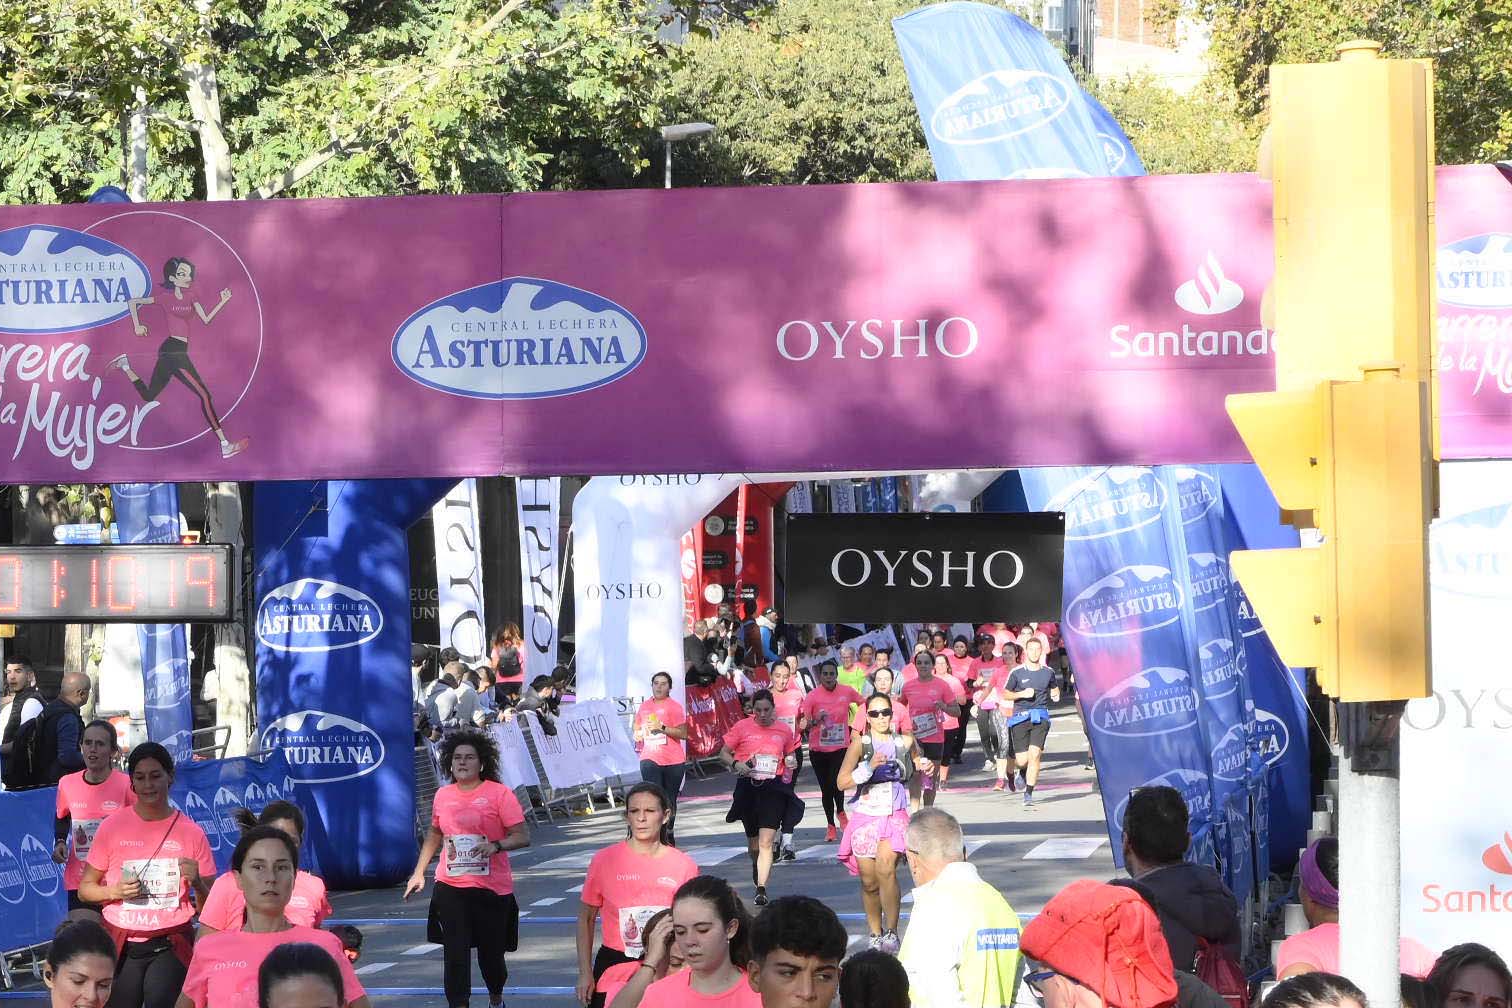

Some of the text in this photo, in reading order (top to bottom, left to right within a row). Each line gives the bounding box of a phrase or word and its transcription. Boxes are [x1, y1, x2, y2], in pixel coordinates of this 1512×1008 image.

[54, 261, 126, 271] LECHERA
[450, 319, 619, 333] CENTRAL LECHERA
[412, 325, 627, 368] ASTURIANA
[777, 316, 979, 362] OYSHO
[1110, 323, 1275, 358] Santand
[12, 374, 160, 470] Mujer
[831, 548, 1025, 589] OYSHO
[586, 581, 663, 600] OYSHO
[273, 603, 370, 612] CENTRAL LECHERA
[261, 611, 375, 636] ASTURIANA
[566, 713, 612, 751] OYSHO
[286, 746, 375, 765] TURIANA
[119, 910, 160, 927] SUMA
